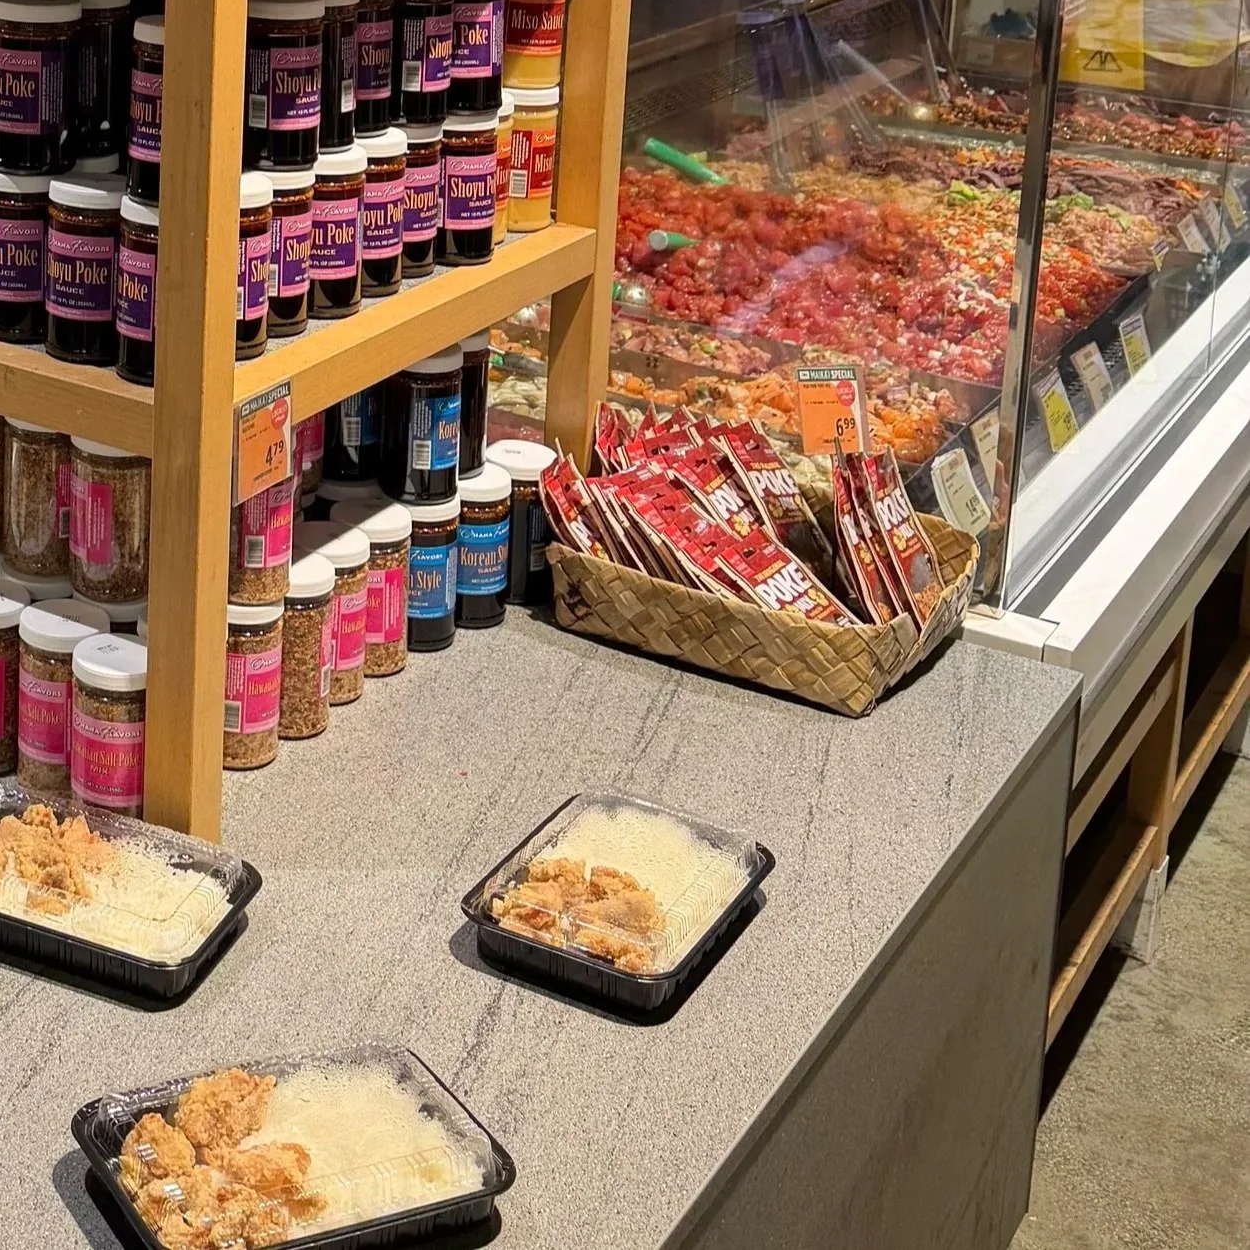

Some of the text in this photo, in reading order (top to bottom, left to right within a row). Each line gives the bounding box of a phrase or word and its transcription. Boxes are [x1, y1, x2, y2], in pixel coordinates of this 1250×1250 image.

[511, 9, 539, 30] Miso
[461, 24, 488, 46] Poke
[6, 72, 36, 98] Poke
[275, 71, 312, 96] Shoyu
[403, 187, 434, 212] Shoyu
[450, 177, 485, 200] Shoyu
[327, 222, 355, 246] Poke
[366, 228, 394, 236] SAUCE
[7, 243, 38, 267] Poke
[75, 260, 108, 285] Poke
[55, 284, 85, 295] SAUCE
[123, 272, 148, 302] Poke
[831, 369, 855, 380] SPECIAL
[267, 384, 290, 403] SPECIAL
[748, 469, 800, 497] POKE
[708, 478, 745, 521] POK
[461, 547, 496, 566] Korean
[417, 571, 442, 589] Style
[754, 560, 813, 611] POKE
[793, 594, 817, 613] MIX
[26, 704, 60, 725] Salt Poke
[100, 748, 139, 767] Salt Poke
[90, 764, 109, 775] MIX
